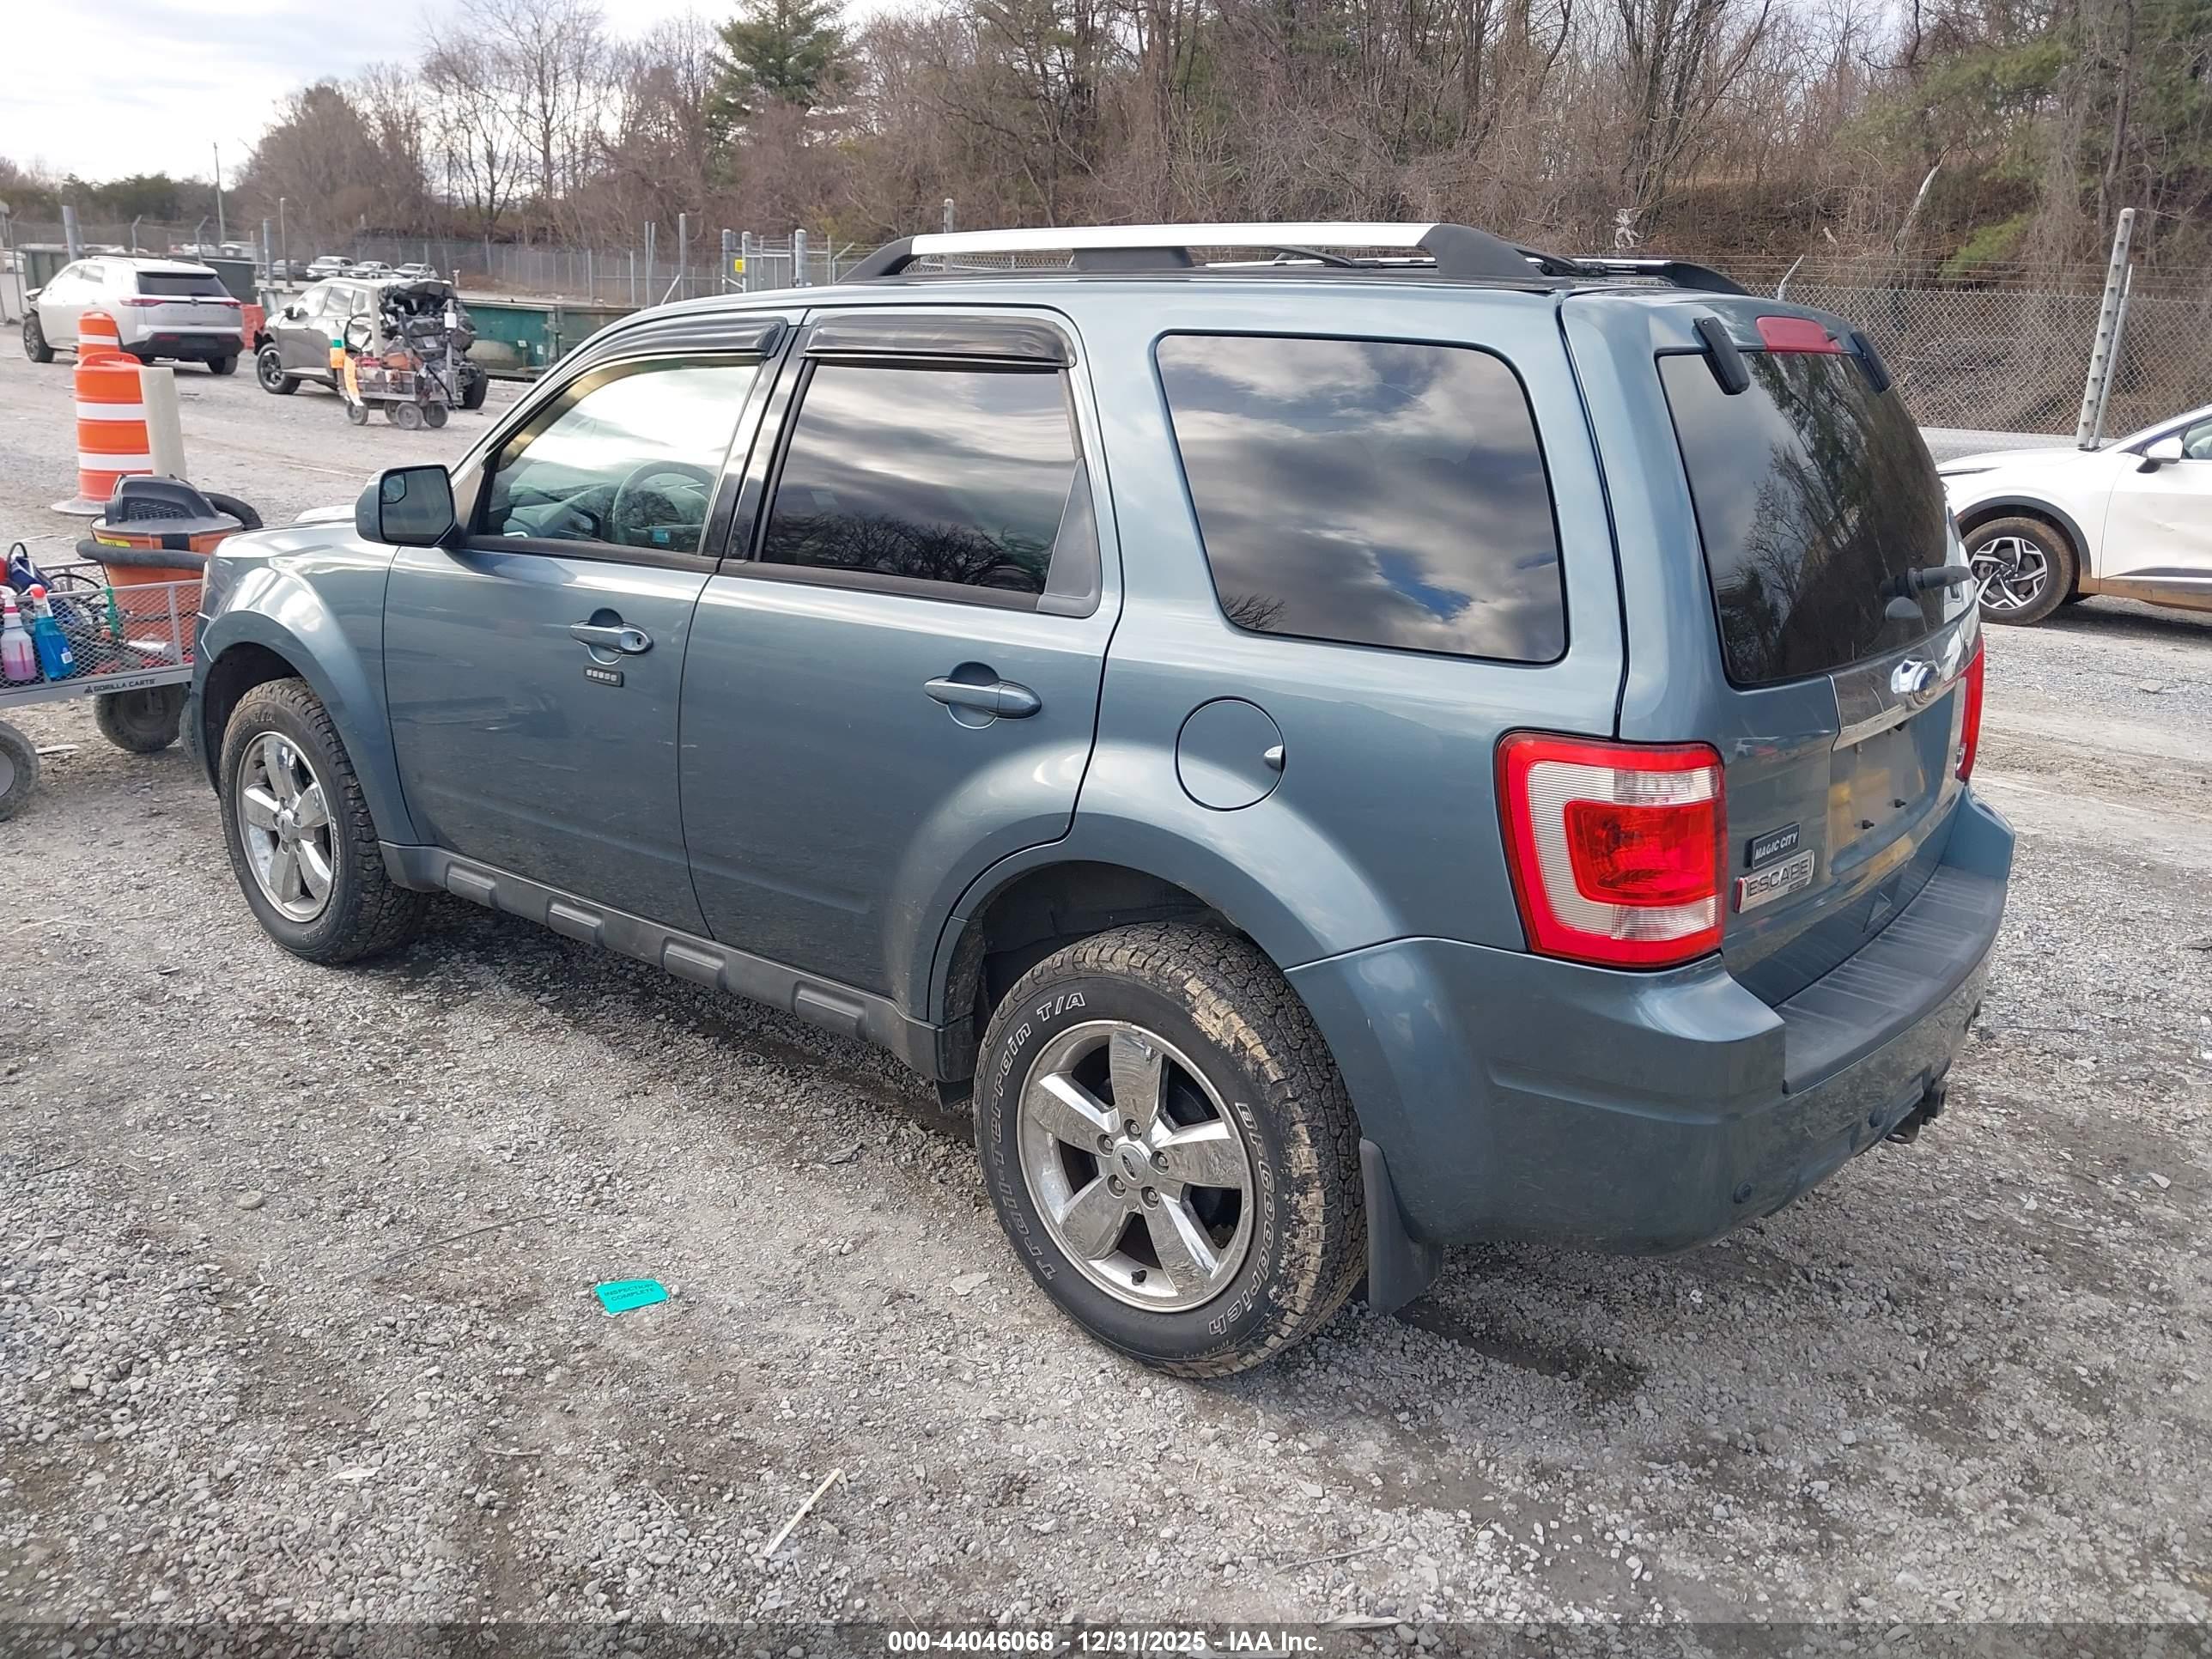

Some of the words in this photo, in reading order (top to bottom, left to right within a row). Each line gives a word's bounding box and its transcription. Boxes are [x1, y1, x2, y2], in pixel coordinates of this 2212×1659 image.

[94, 682, 127, 692] GORILLA
[1754, 839, 1780, 860] MAGIC
[1780, 832, 1798, 848] CITY
[1748, 858, 1808, 897] ESCAPE
[1036, 992, 1086, 1022] T/A
[1209, 1102, 1276, 1335] BFGoodrich
[604, 1283, 653, 1297] INSPECTION
[611, 1287, 654, 1301] COMPLETE
